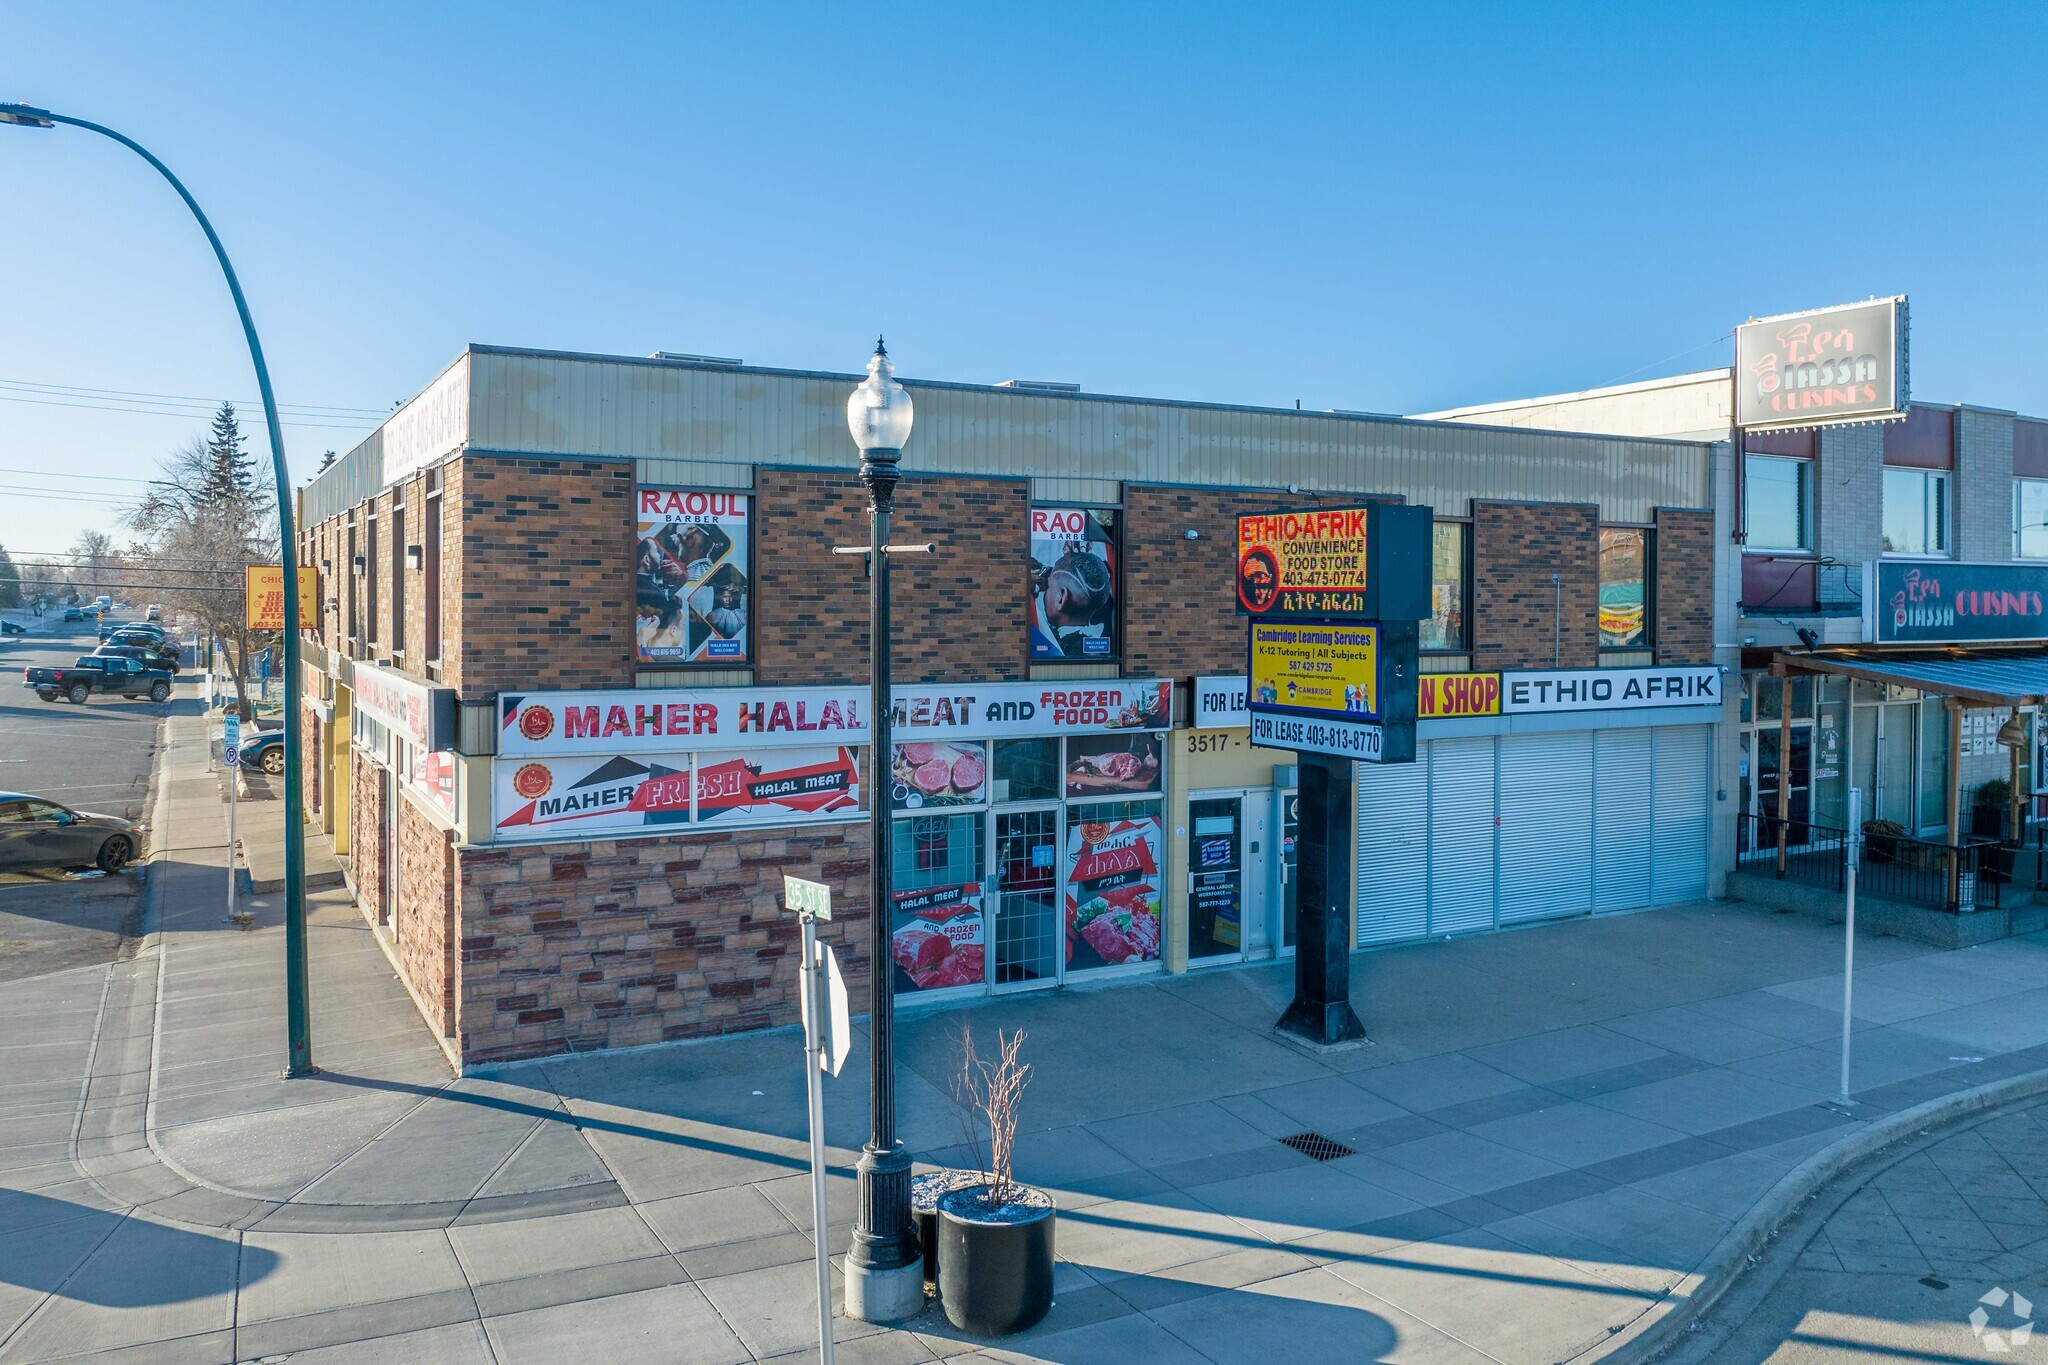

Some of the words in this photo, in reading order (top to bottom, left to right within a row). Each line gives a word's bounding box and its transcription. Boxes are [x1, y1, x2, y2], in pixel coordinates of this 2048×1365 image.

[1770, 384, 1876, 412] CUISINES
[641, 490, 745, 516] RAOUL
[665, 514, 719, 523] BARBER
[1032, 511, 1084, 533] RAO
[1283, 540, 1364, 555] CONVENIENCE
[1288, 557, 1317, 570] FOOD
[1320, 556, 1358, 569] STORE
[1283, 571, 1364, 586] 403-475-0774
[1956, 590, 2043, 616] CUISINES
[1257, 628, 1297, 644] Cambridge
[1298, 630, 1333, 646] Learning
[1334, 631, 1371, 647] Services
[650, 648, 660, 656] 403
[1259, 646, 1275, 656] K-12
[1277, 647, 1310, 659] Tutoring
[1317, 649, 1328, 658] All
[1331, 649, 1367, 661] Subjects
[1289, 660, 1300, 670] 587
[1302, 661, 1314, 671] 429
[1316, 662, 1333, 672] 5725
[1298, 686, 1332, 696] CAMBRIDGE
[1442, 676, 1498, 714] SHOP
[1511, 679, 1613, 705] ETHIO
[1622, 675, 1715, 700] AFRIK
[1203, 692, 1226, 712] FOR
[564, 702, 719, 738] MAHER
[738, 699, 868, 733] HALAL
[986, 701, 1035, 722] AND
[1040, 690, 1122, 708] FROZEN
[1053, 708, 1109, 726] FOOD
[1188, 734, 1229, 753] 3517
[1255, 718, 1272, 740] FOR
[1275, 721, 1303, 743] LEASE
[1306, 725, 1380, 753] 403-813-8770
[540, 784, 634, 816] MAHER
[645, 770, 741, 807] FRESH
[754, 780, 798, 796] HALAL
[805, 773, 842, 788] MEAT
[788, 882, 802, 906] 35
[806, 886, 815, 910] ST
[818, 889, 828, 914] SE
[900, 897, 930, 910] HALAL
[934, 889, 959, 902] MEAT
[924, 922, 940, 932] AND
[944, 924, 981, 934] FROZEN
[950, 932, 975, 941] FOOD
